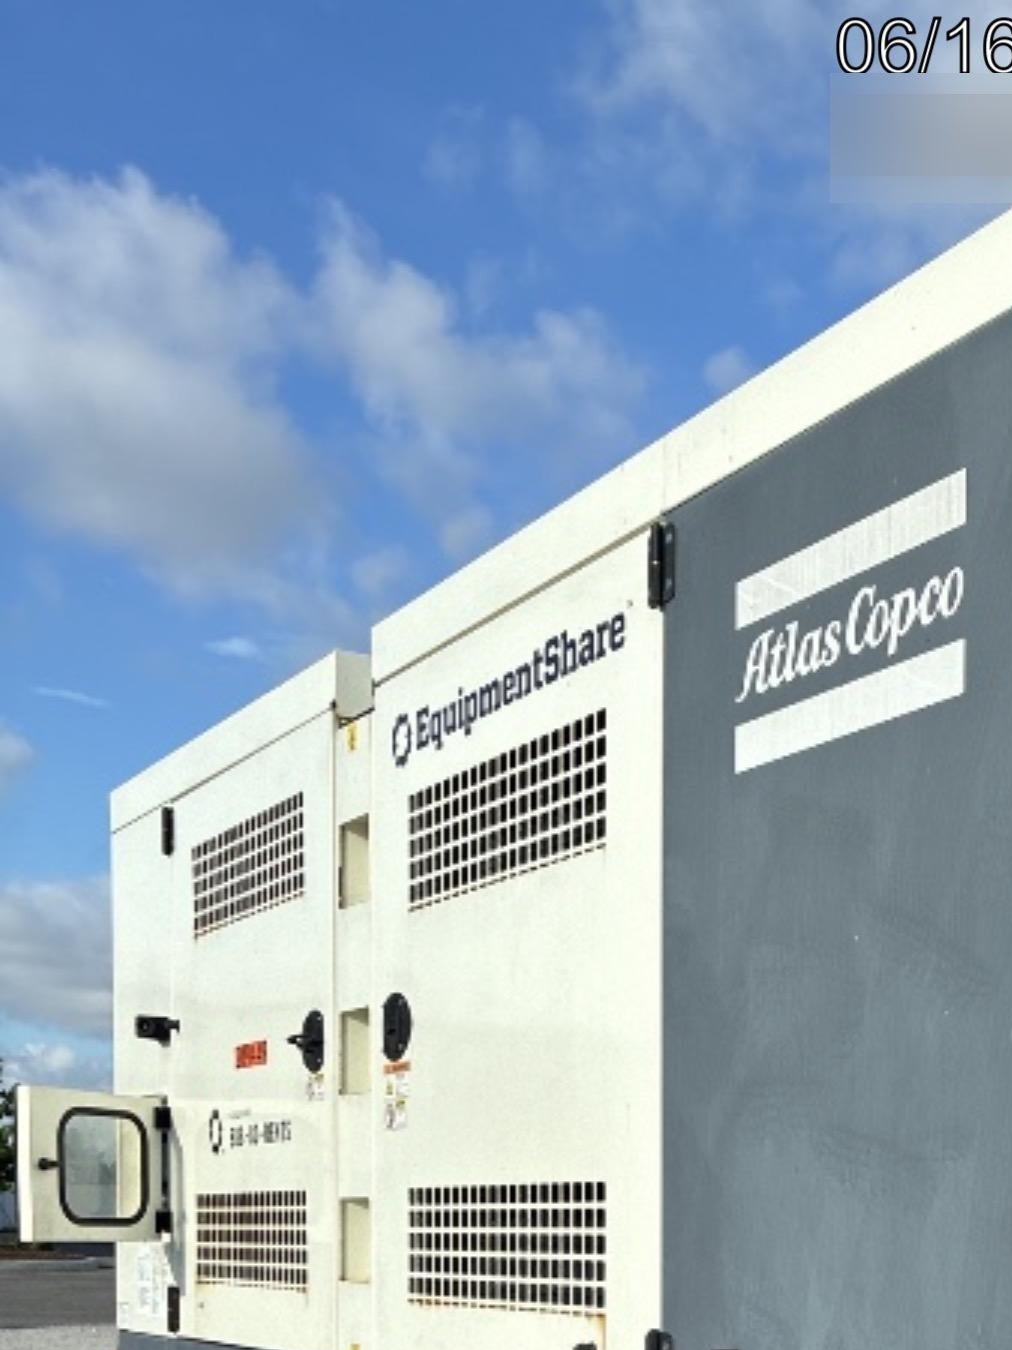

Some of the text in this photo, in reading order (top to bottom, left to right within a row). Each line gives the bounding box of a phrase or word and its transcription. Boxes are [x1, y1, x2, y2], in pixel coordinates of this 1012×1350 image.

[415, 611, 626, 751] EquipmentShare
[734, 566, 965, 703] Atlas Copco
